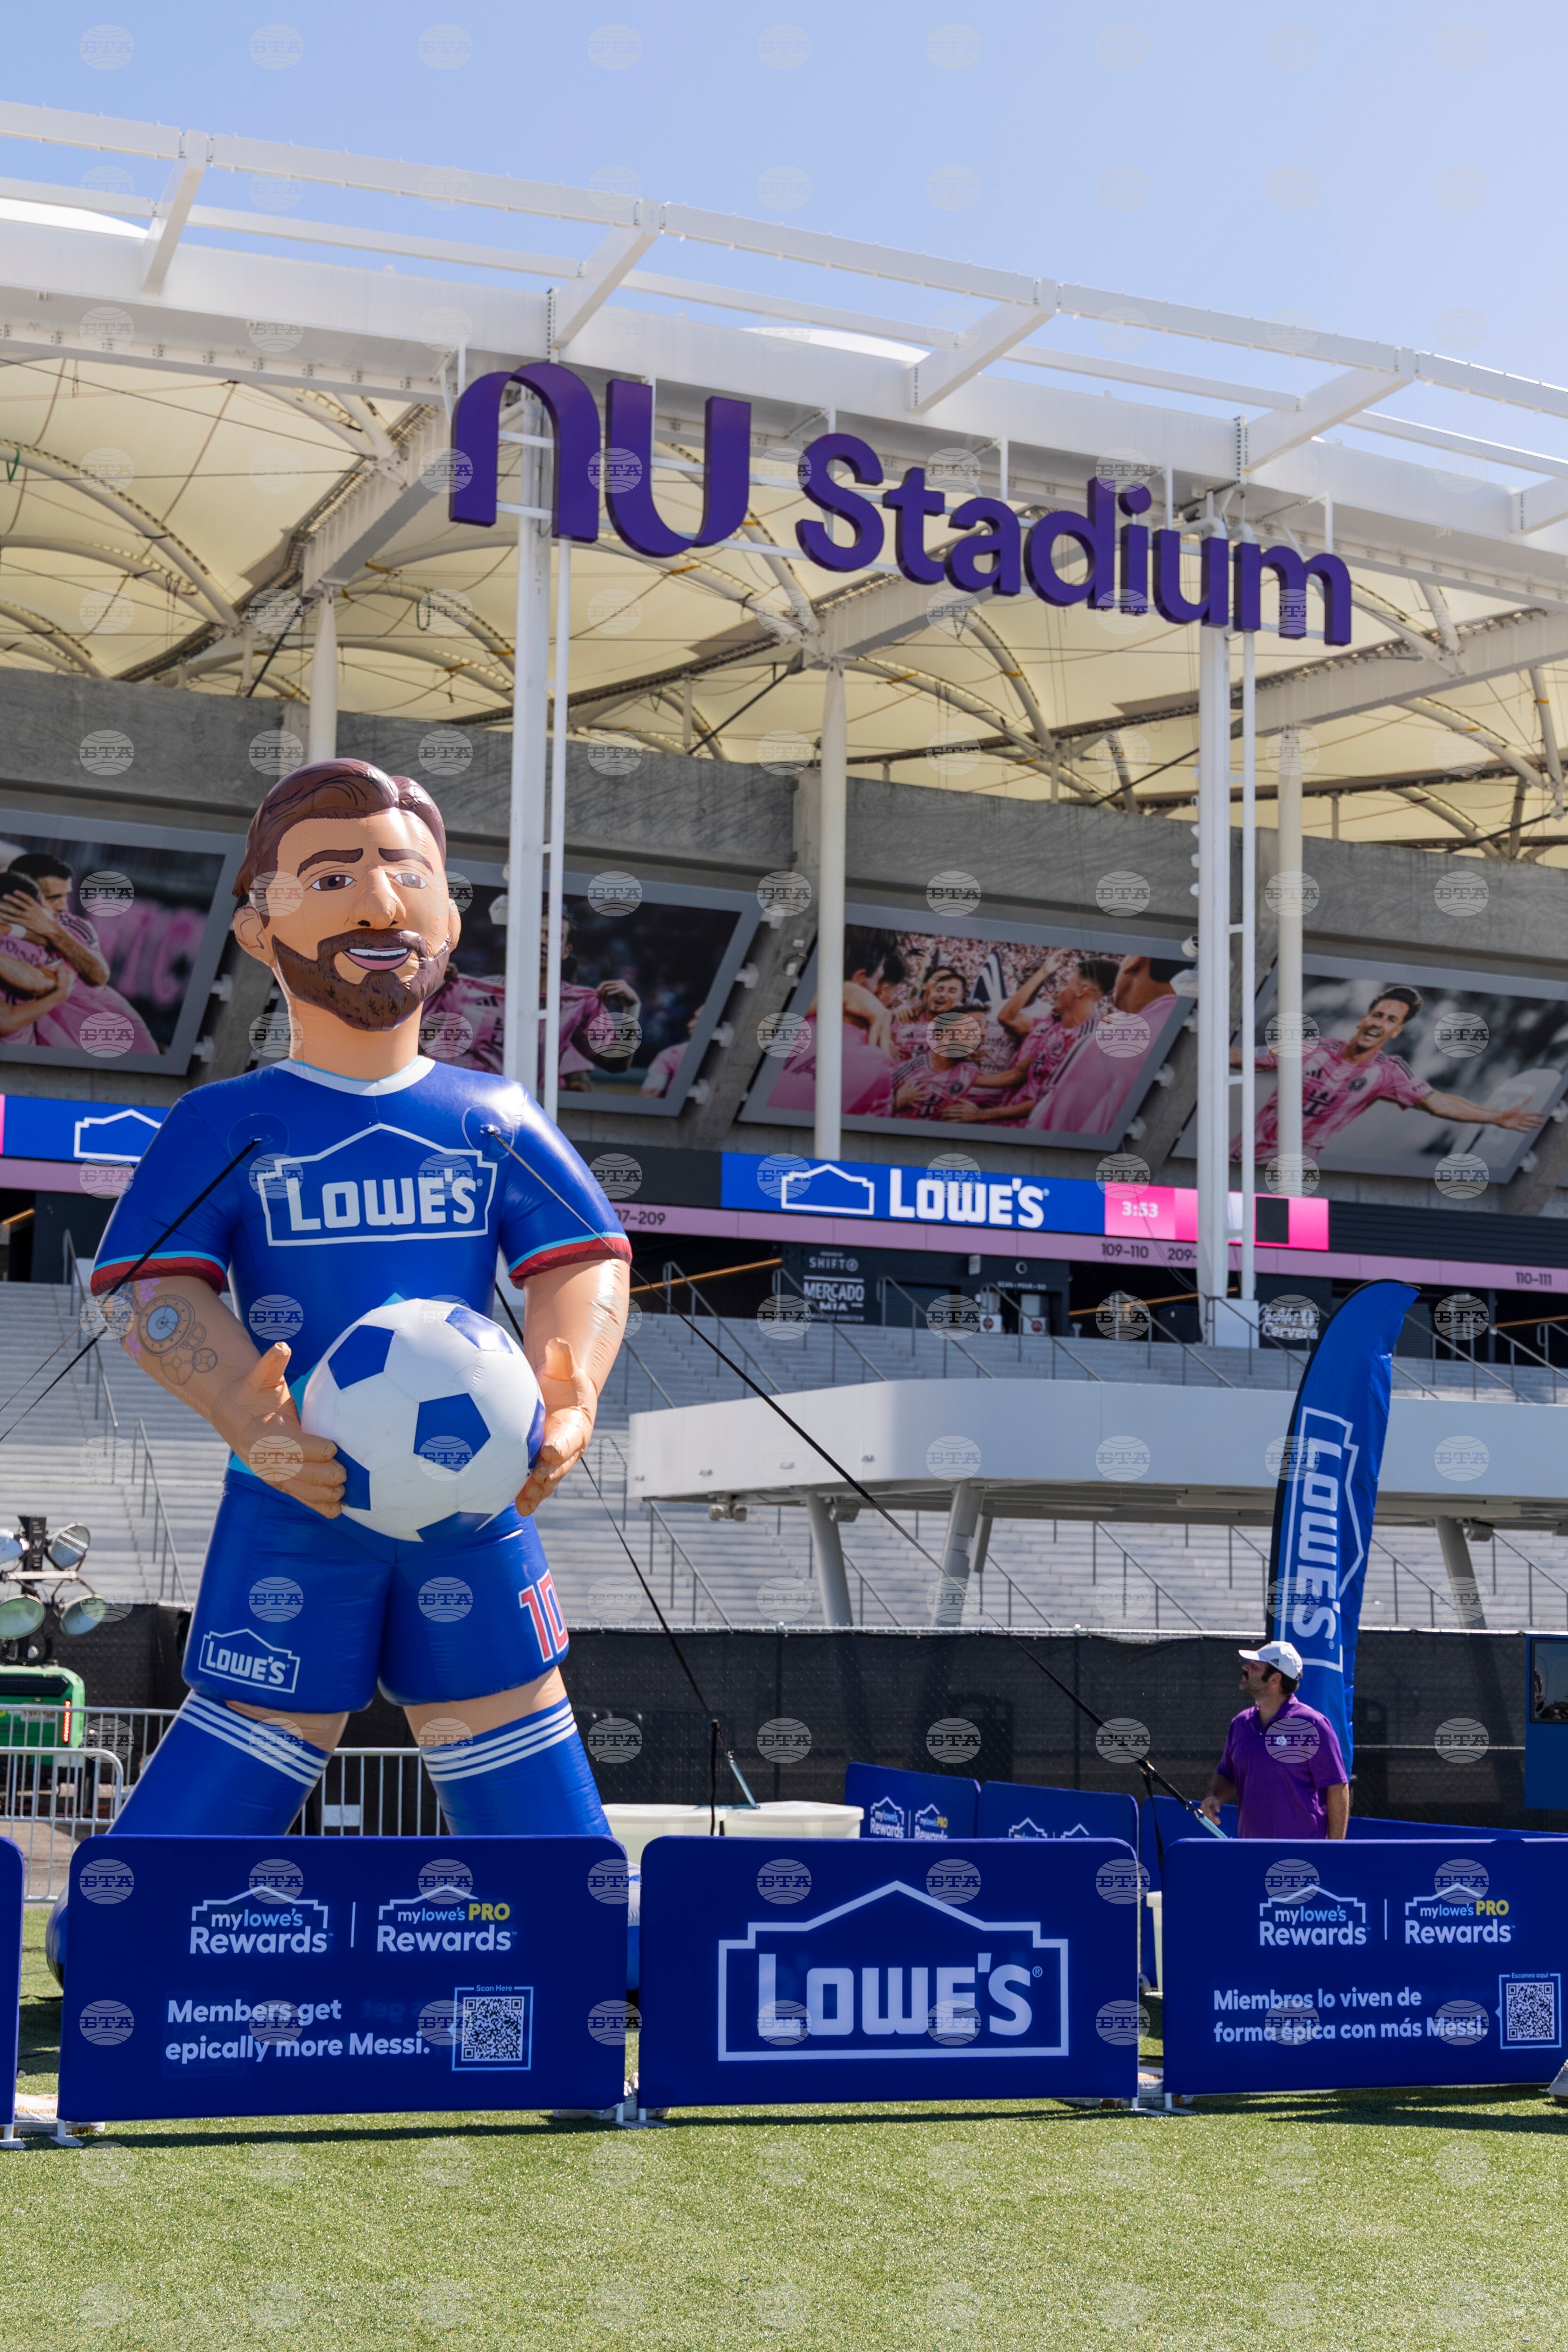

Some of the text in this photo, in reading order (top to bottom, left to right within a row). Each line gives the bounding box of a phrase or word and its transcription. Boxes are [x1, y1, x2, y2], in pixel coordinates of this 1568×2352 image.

[796, 432, 1352, 647] Stadium
[1122, 1201, 1158, 1218] 3:53
[804, 1281, 865, 1302] MERCADO
[1516, 1272, 1552, 1286] 110-111
[518, 1569, 569, 1662] 10
[870, 1816, 904, 1839] Rewards
[190, 1926, 328, 1954] Rewards
[377, 1924, 511, 1952] Rewards
[1259, 1921, 1367, 1946] Rewards
[1405, 1919, 1512, 1944] Rewards
[1214, 1986, 1422, 2010] Miembros lo viven de
[168, 1999, 342, 2026] Members get
[1214, 2015, 1488, 2044] forma épica con más Messi.
[166, 2030, 430, 2064] epically more Messi.
